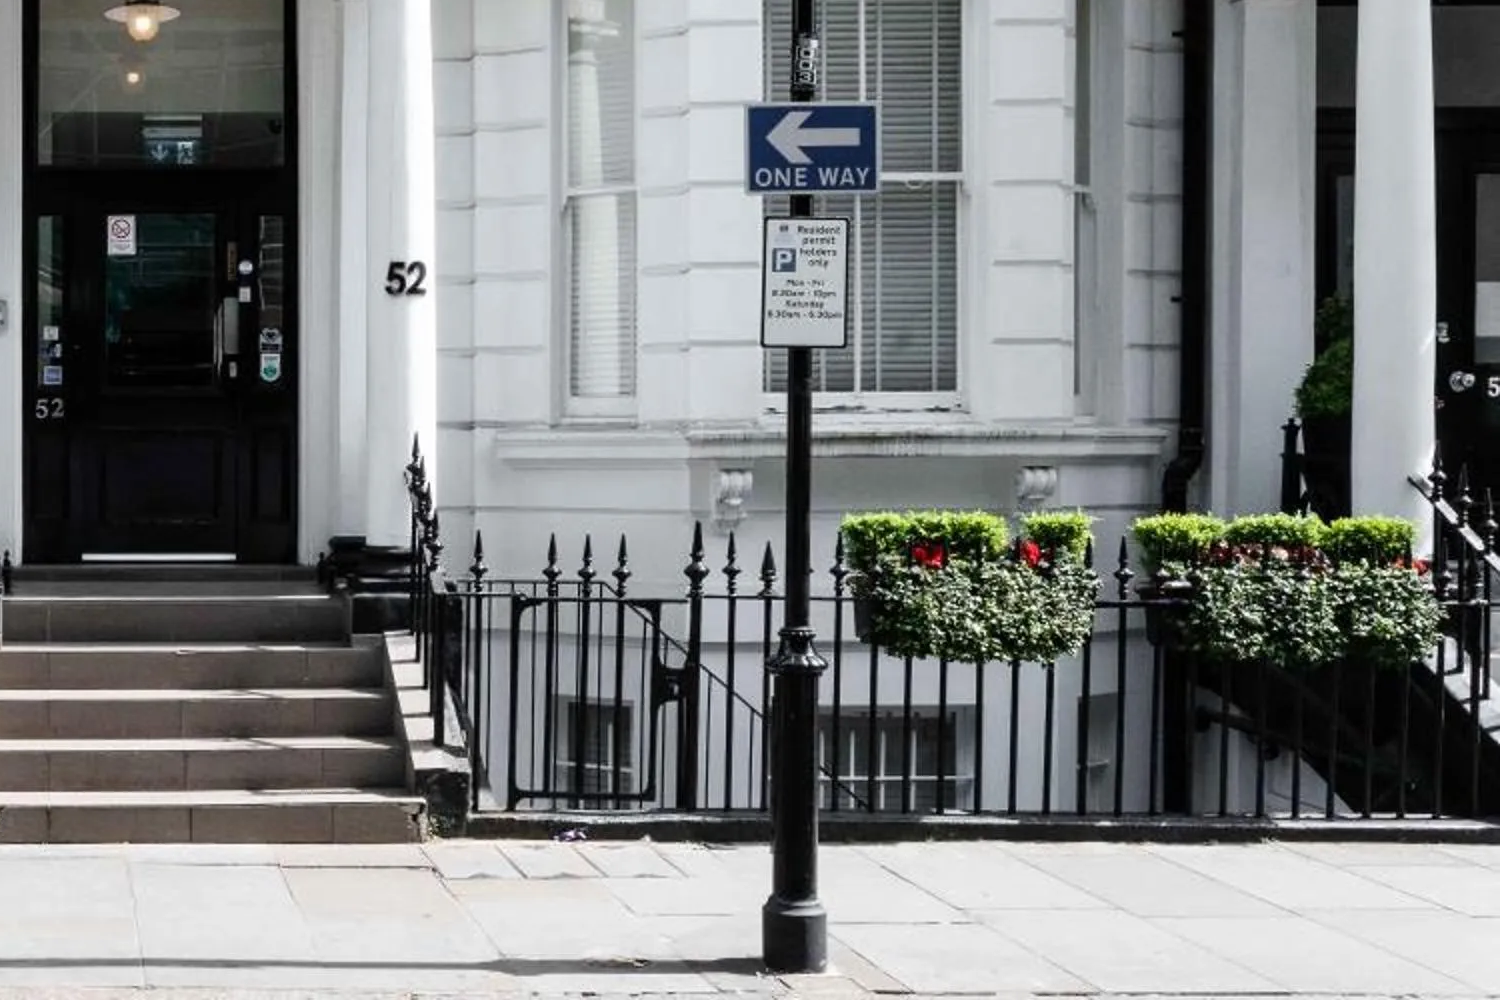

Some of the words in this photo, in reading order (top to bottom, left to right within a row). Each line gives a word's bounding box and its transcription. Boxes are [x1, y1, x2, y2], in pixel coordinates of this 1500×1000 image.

[755, 167, 807, 187] ONE
[818, 167, 869, 187] WAY
[797, 225, 841, 234] Resident
[802, 237, 836, 246] permit
[799, 247, 837, 257] holders
[775, 250, 793, 271] P
[808, 258, 829, 270] only
[384, 260, 427, 297] 52
[786, 300, 824, 309] Saturday
[35, 397, 65, 419] 52
